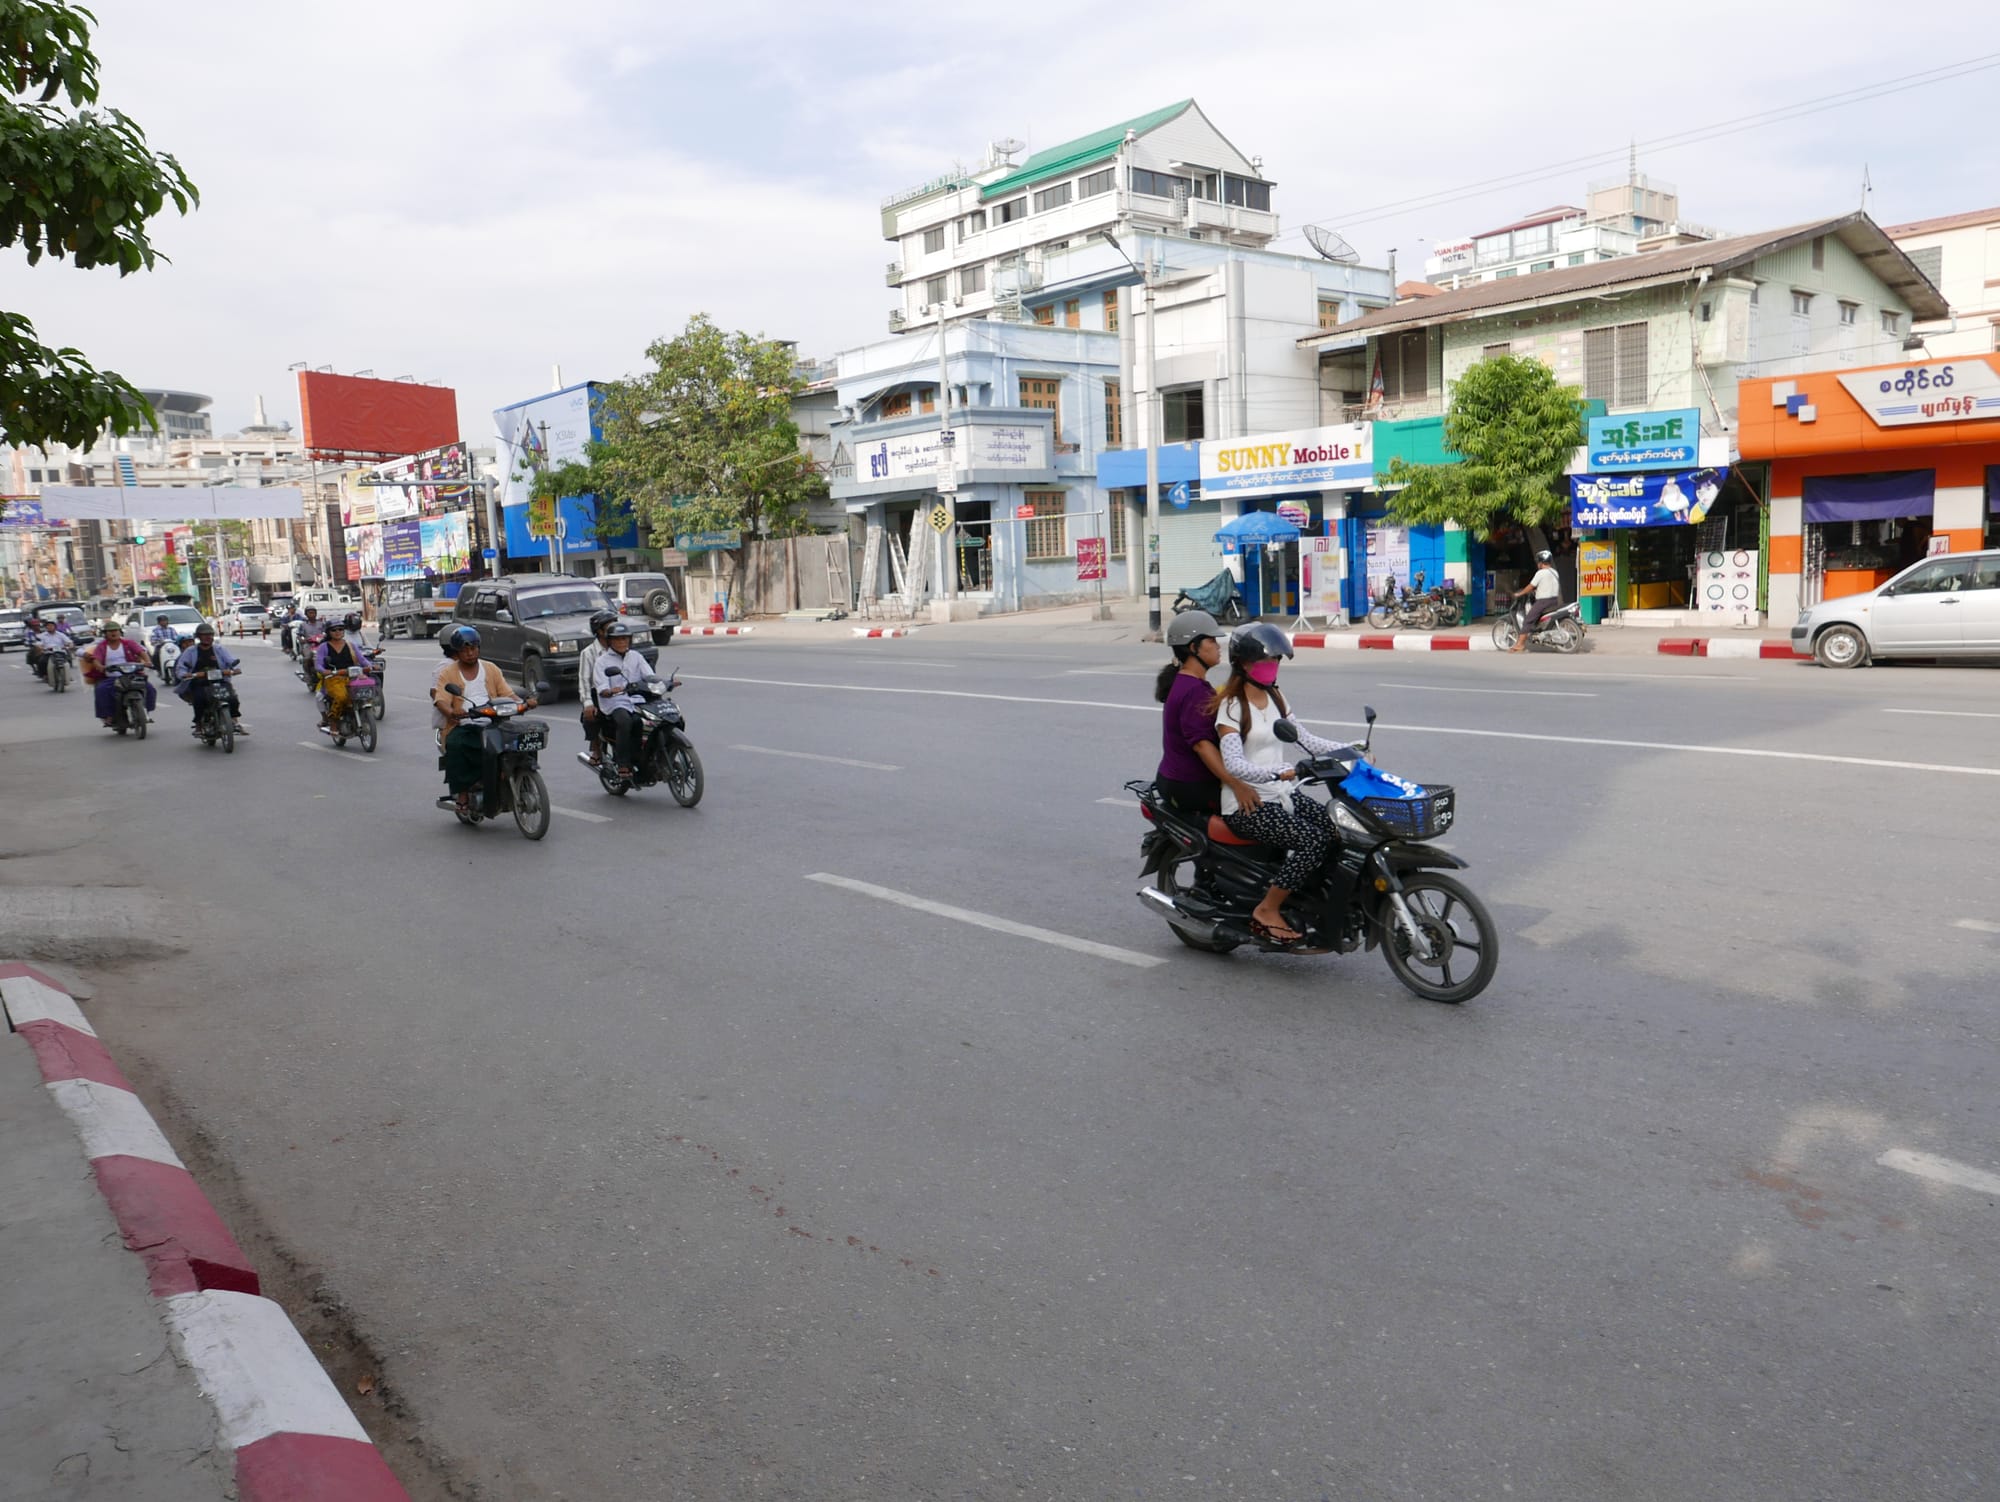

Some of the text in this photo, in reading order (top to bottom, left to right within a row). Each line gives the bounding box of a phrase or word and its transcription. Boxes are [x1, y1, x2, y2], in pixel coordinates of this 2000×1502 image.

[1442, 253, 1467, 264] HOTEL
[1218, 442, 1291, 472] SUNNY
[1294, 443, 1350, 465] Mobile
[1584, 565, 1613, 591] မျက်မှန်
